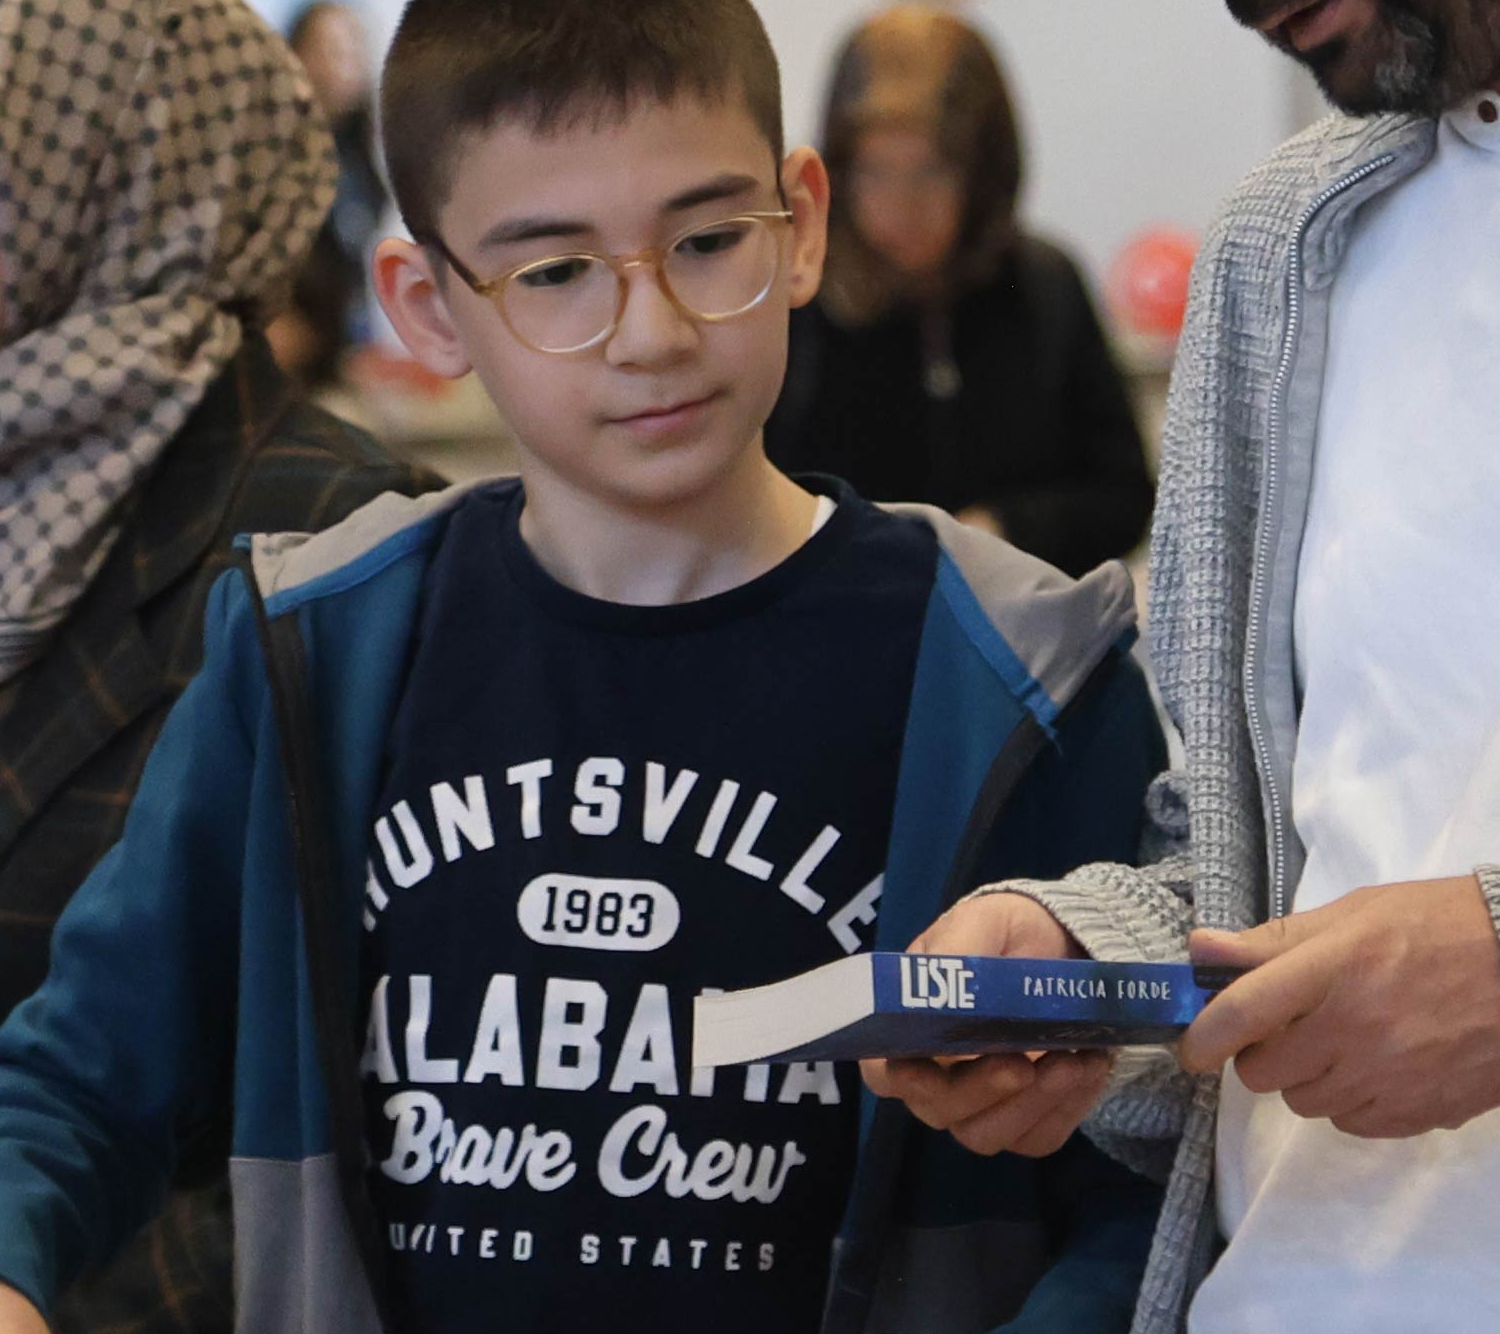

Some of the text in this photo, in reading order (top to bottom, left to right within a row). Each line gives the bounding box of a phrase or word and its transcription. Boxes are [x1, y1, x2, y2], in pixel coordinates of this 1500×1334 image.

[541, 884, 655, 938] 1983
[1022, 974, 1172, 1002] PATRICIA FORDE
[382, 1091, 807, 1206] Brave Crew
[580, 1234, 777, 1272] STATES
